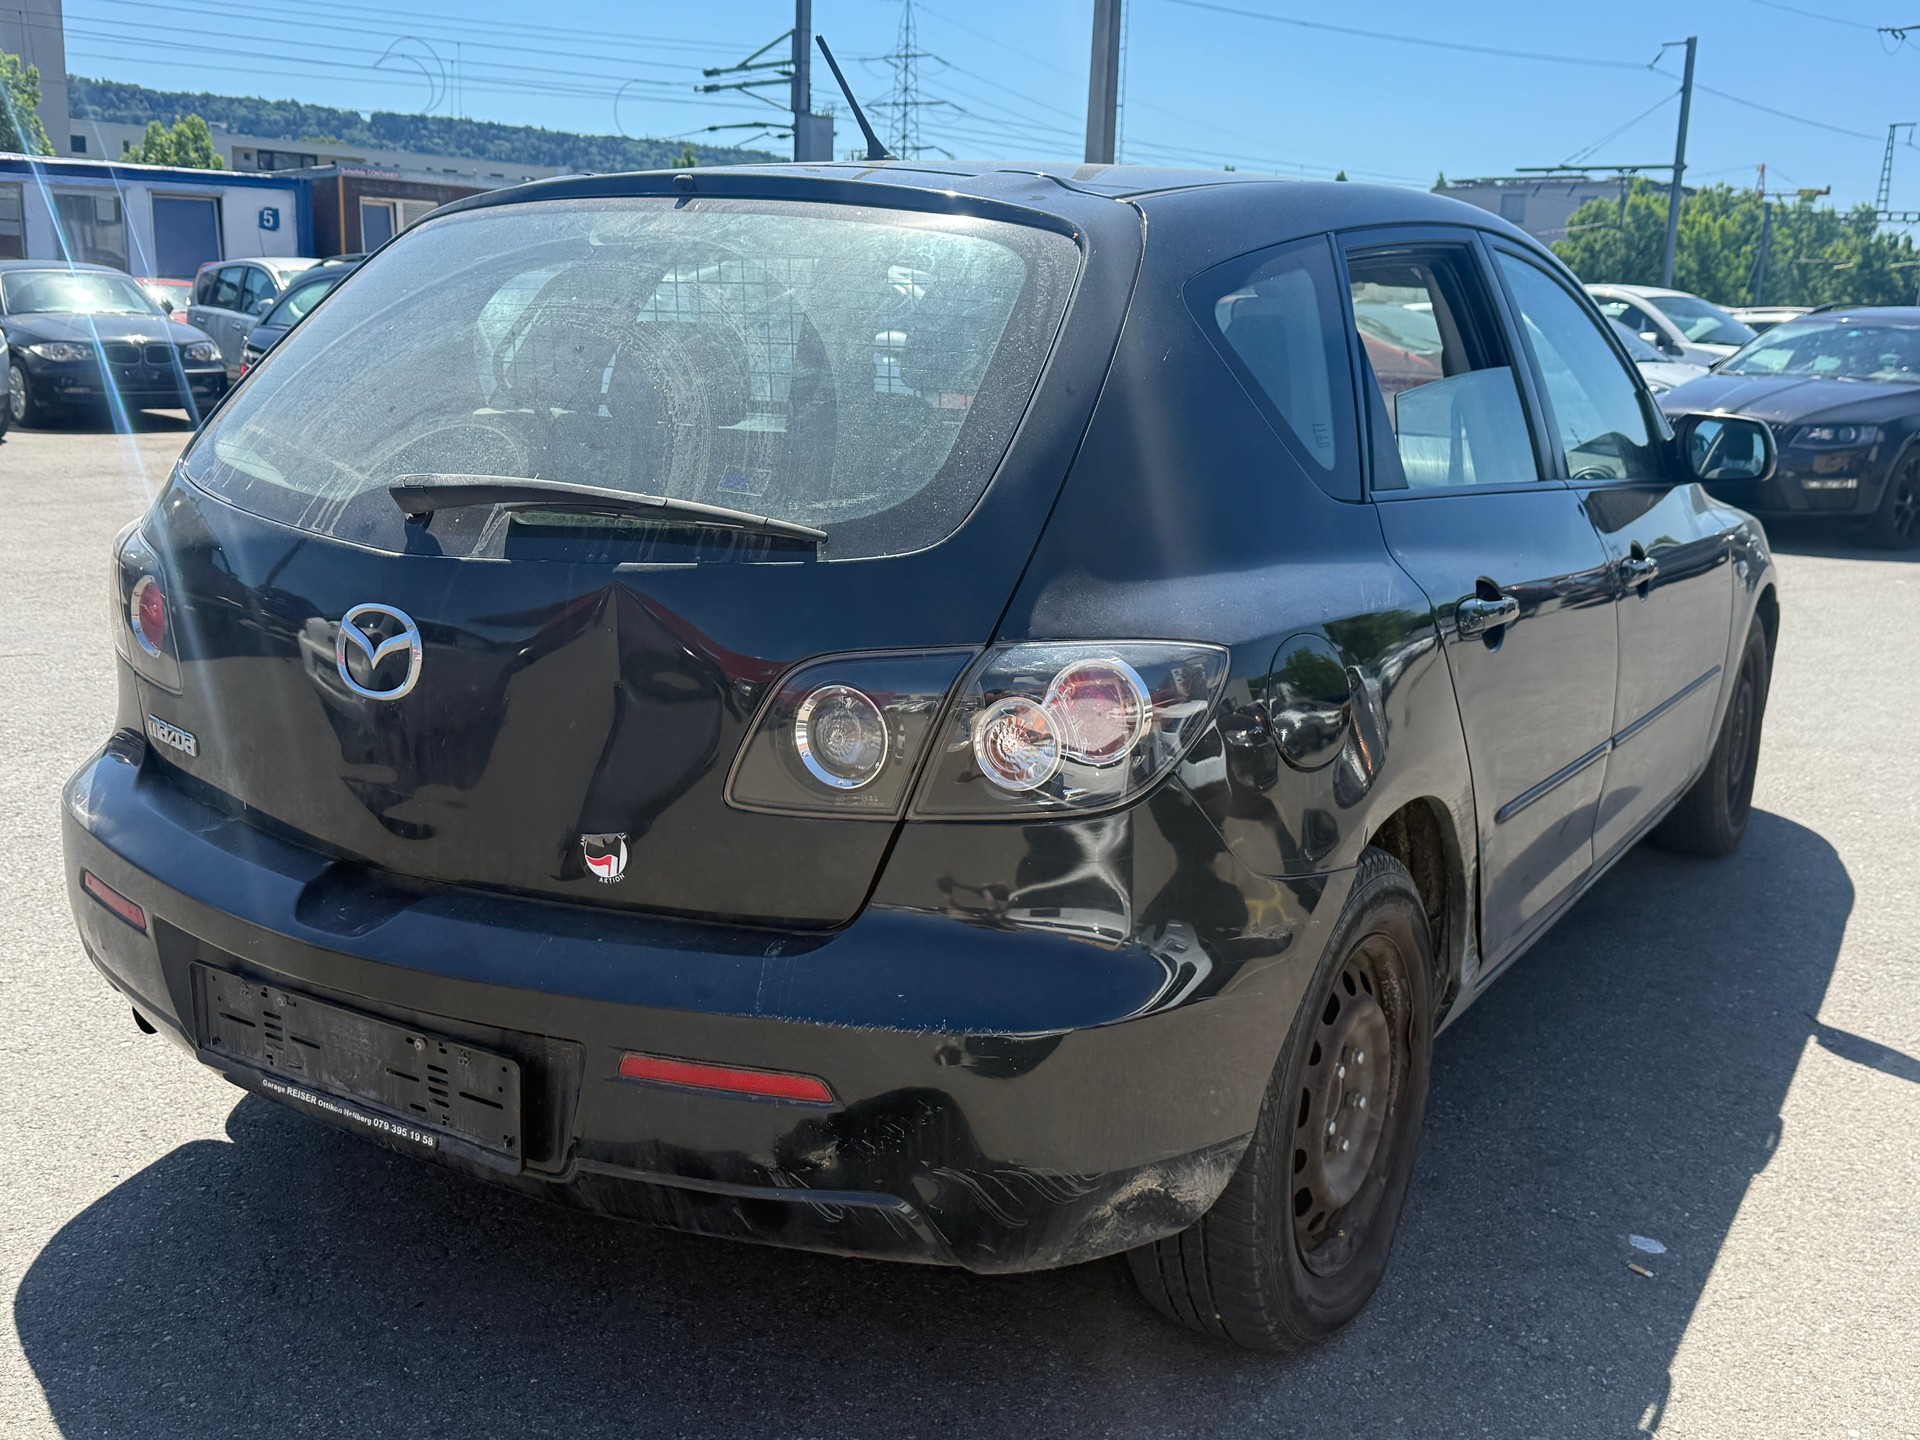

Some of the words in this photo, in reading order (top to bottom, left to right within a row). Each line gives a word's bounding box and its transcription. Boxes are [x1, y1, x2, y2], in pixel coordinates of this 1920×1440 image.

[263, 209, 273, 227] 5
[598, 872, 626, 884] AKTION
[262, 1079, 286, 1093] Garage
[286, 1086, 318, 1105] REISER
[317, 1099, 343, 1114] Ottikon
[373, 1117, 390, 1131] 079
[391, 1124, 408, 1137] 395
[409, 1130, 421, 1142] 19
[422, 1135, 434, 1146] 58
